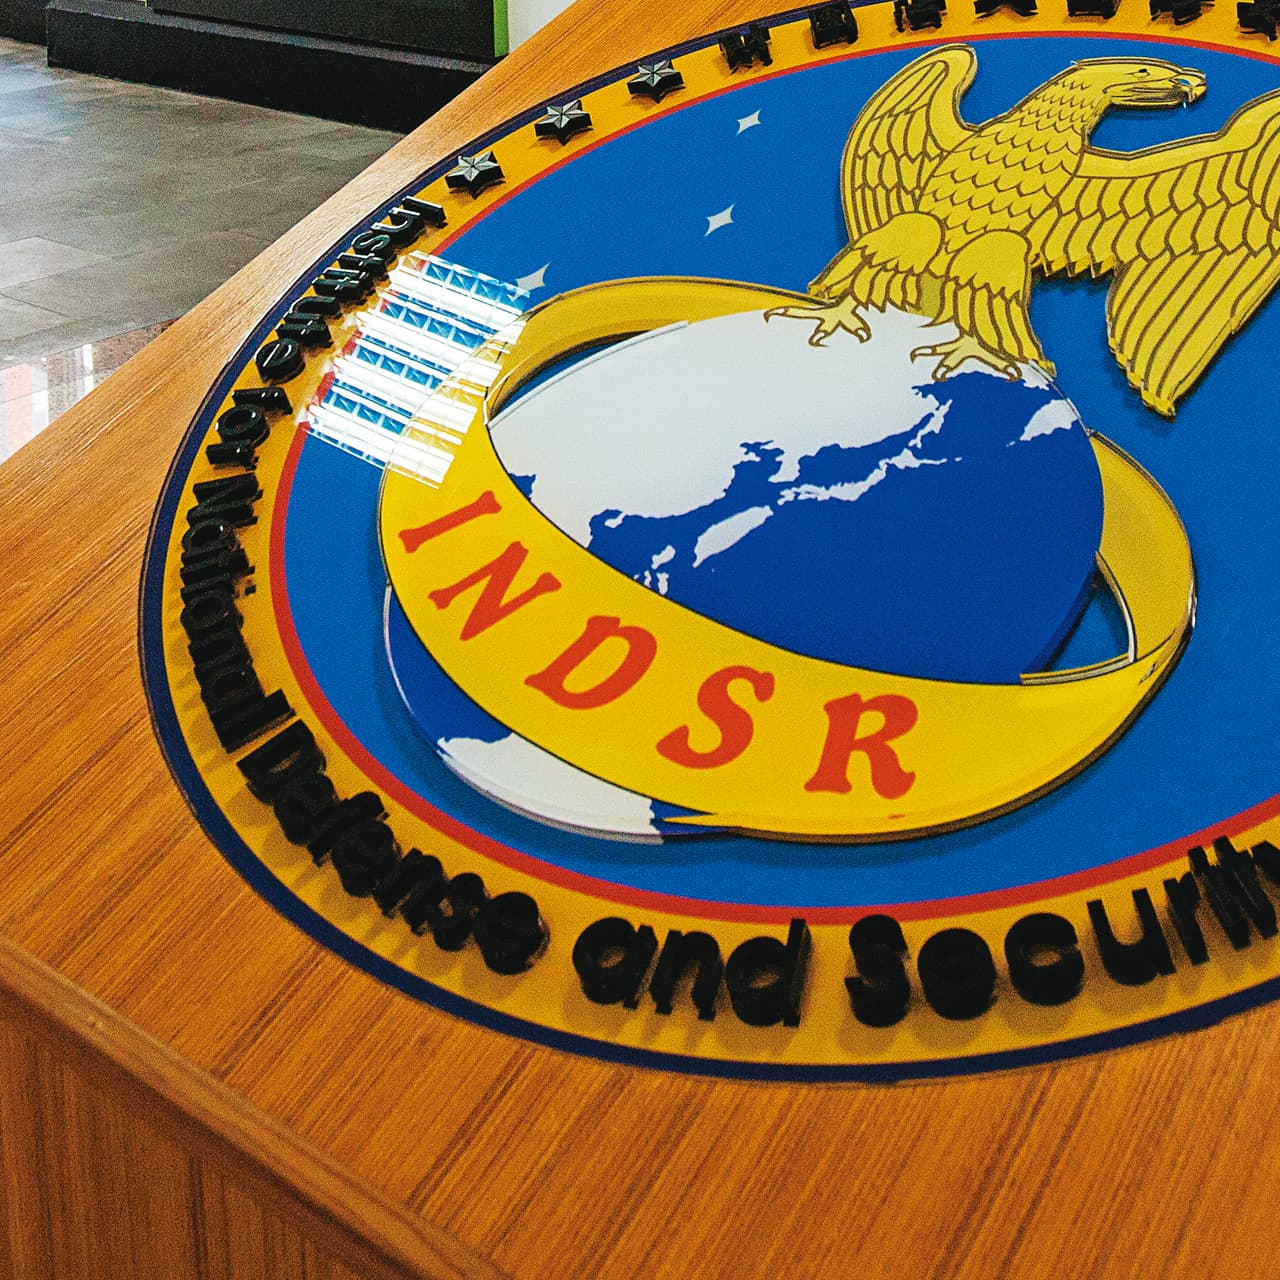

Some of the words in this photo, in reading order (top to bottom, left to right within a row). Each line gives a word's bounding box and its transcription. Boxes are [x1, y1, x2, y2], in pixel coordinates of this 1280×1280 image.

[255, 195, 447, 381] Institute
[206, 387, 293, 470] for
[180, 471, 296, 752] National
[399, 490, 920, 800] INDSR
[237, 720, 550, 977] Defense
[572, 918, 811, 1028] and
